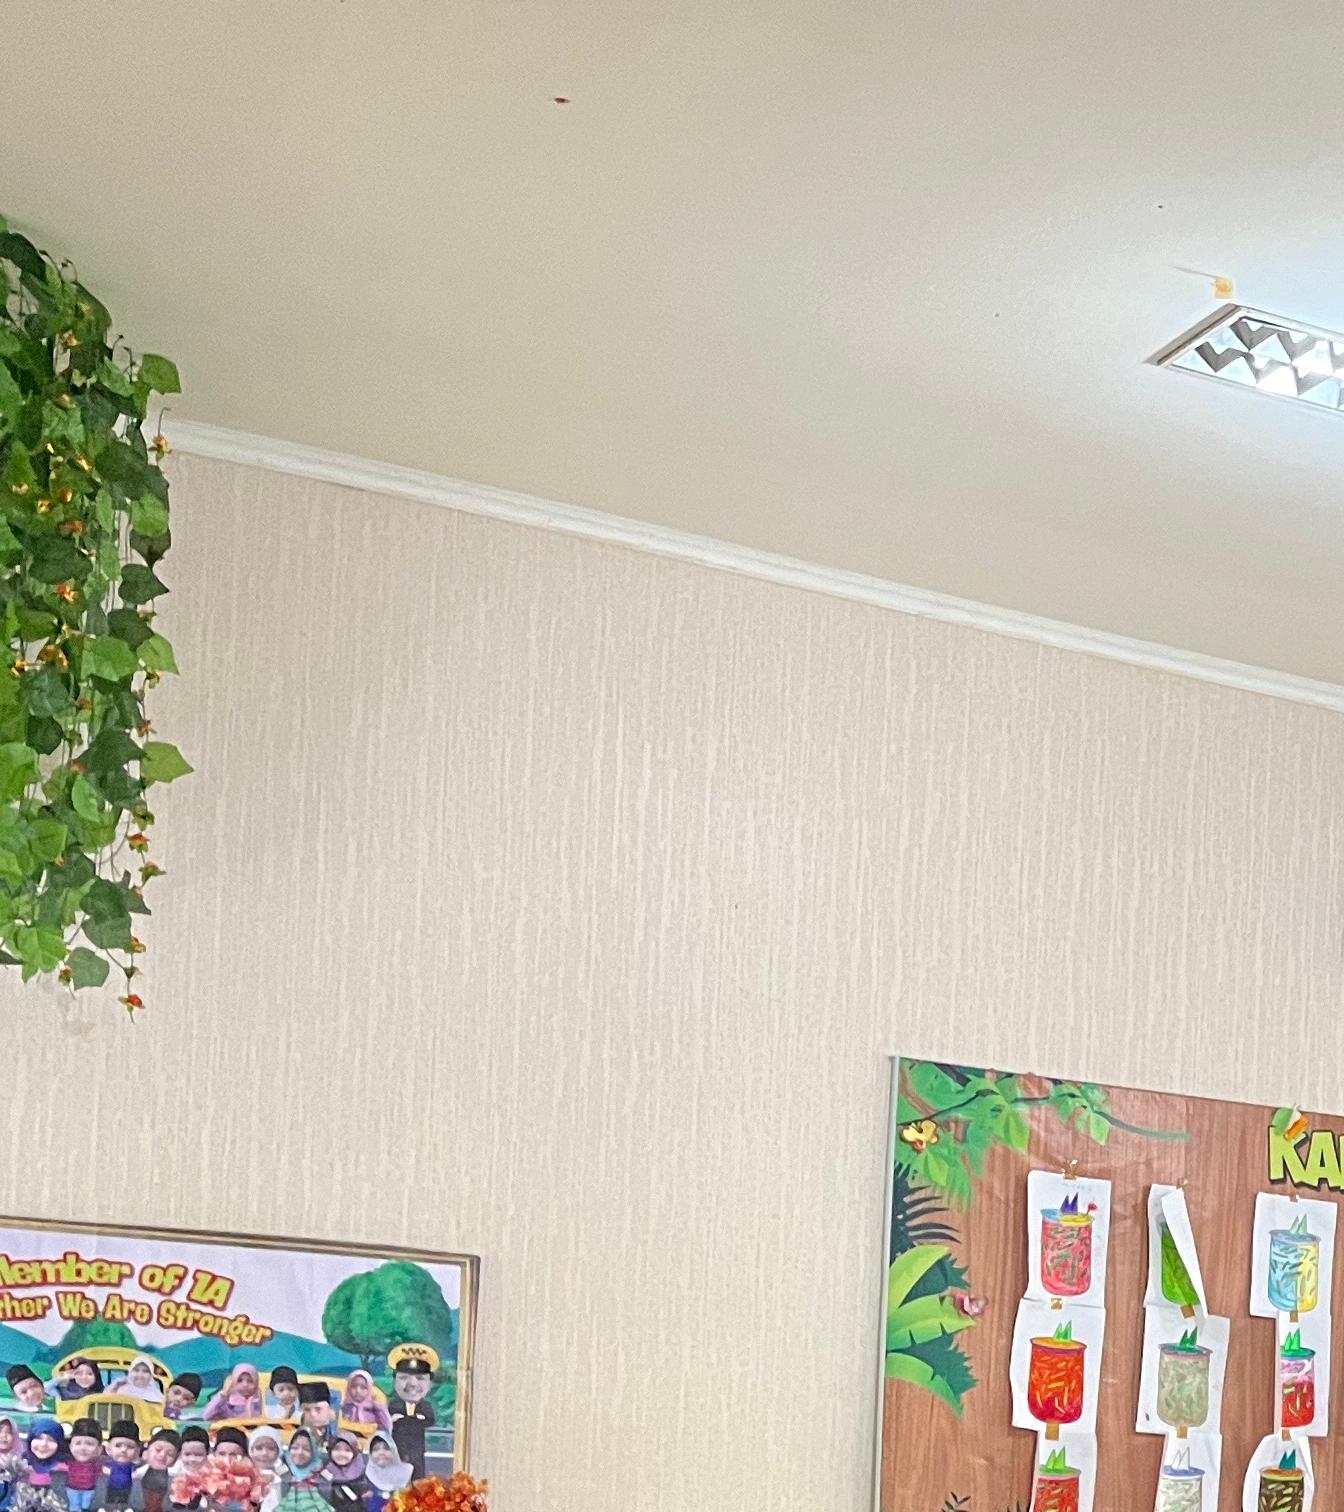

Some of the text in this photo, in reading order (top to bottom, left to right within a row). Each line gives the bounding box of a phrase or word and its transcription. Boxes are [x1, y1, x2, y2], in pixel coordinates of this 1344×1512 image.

[139, 1264, 188, 1295] of
[187, 1270, 234, 1312] 1A
[55, 1291, 98, 1320] We
[103, 1293, 153, 1325] Are
[156, 1299, 274, 1346] Stronger
